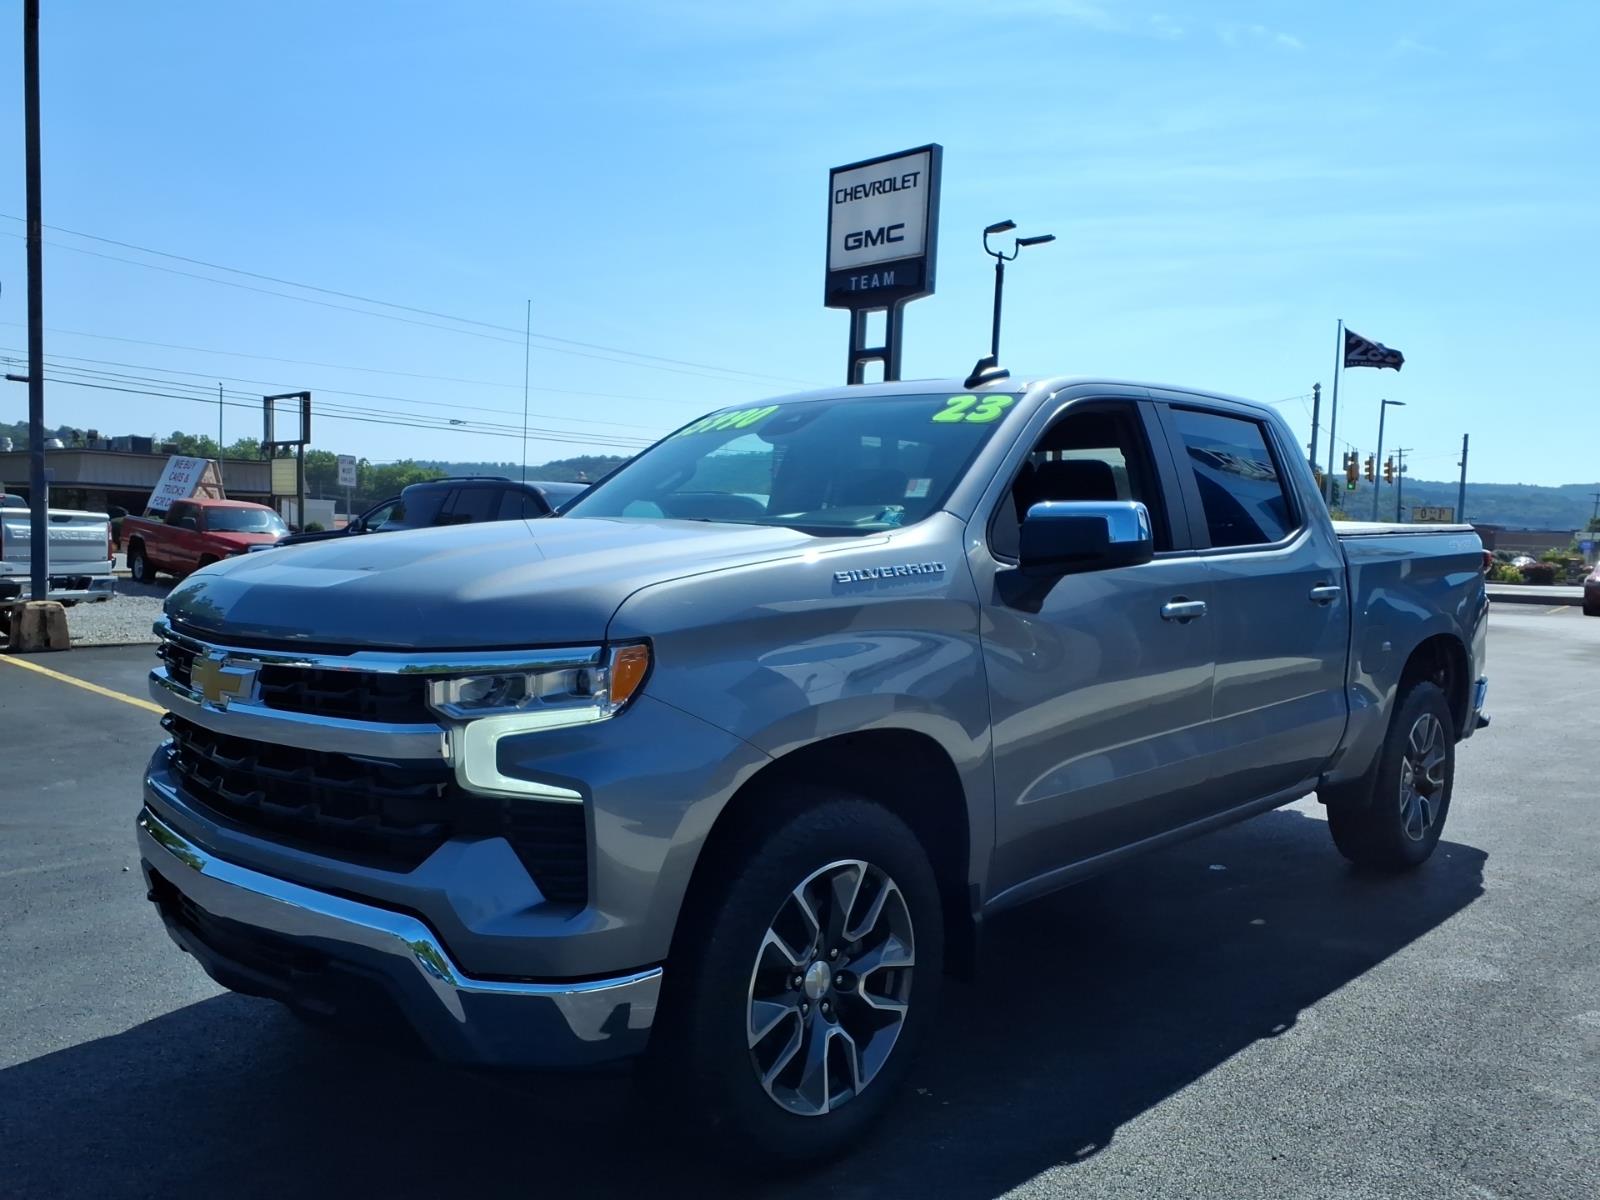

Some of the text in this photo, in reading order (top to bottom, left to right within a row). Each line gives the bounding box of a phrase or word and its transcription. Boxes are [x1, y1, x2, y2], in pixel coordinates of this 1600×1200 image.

[835, 171, 920, 205] CHEVROLET
[844, 222, 905, 252] GMC
[849, 270, 895, 291] TEAM
[931, 393, 1015, 424] 23
[163, 485, 185, 496] TRUCKS
[833, 560, 947, 584] SILVERADO
